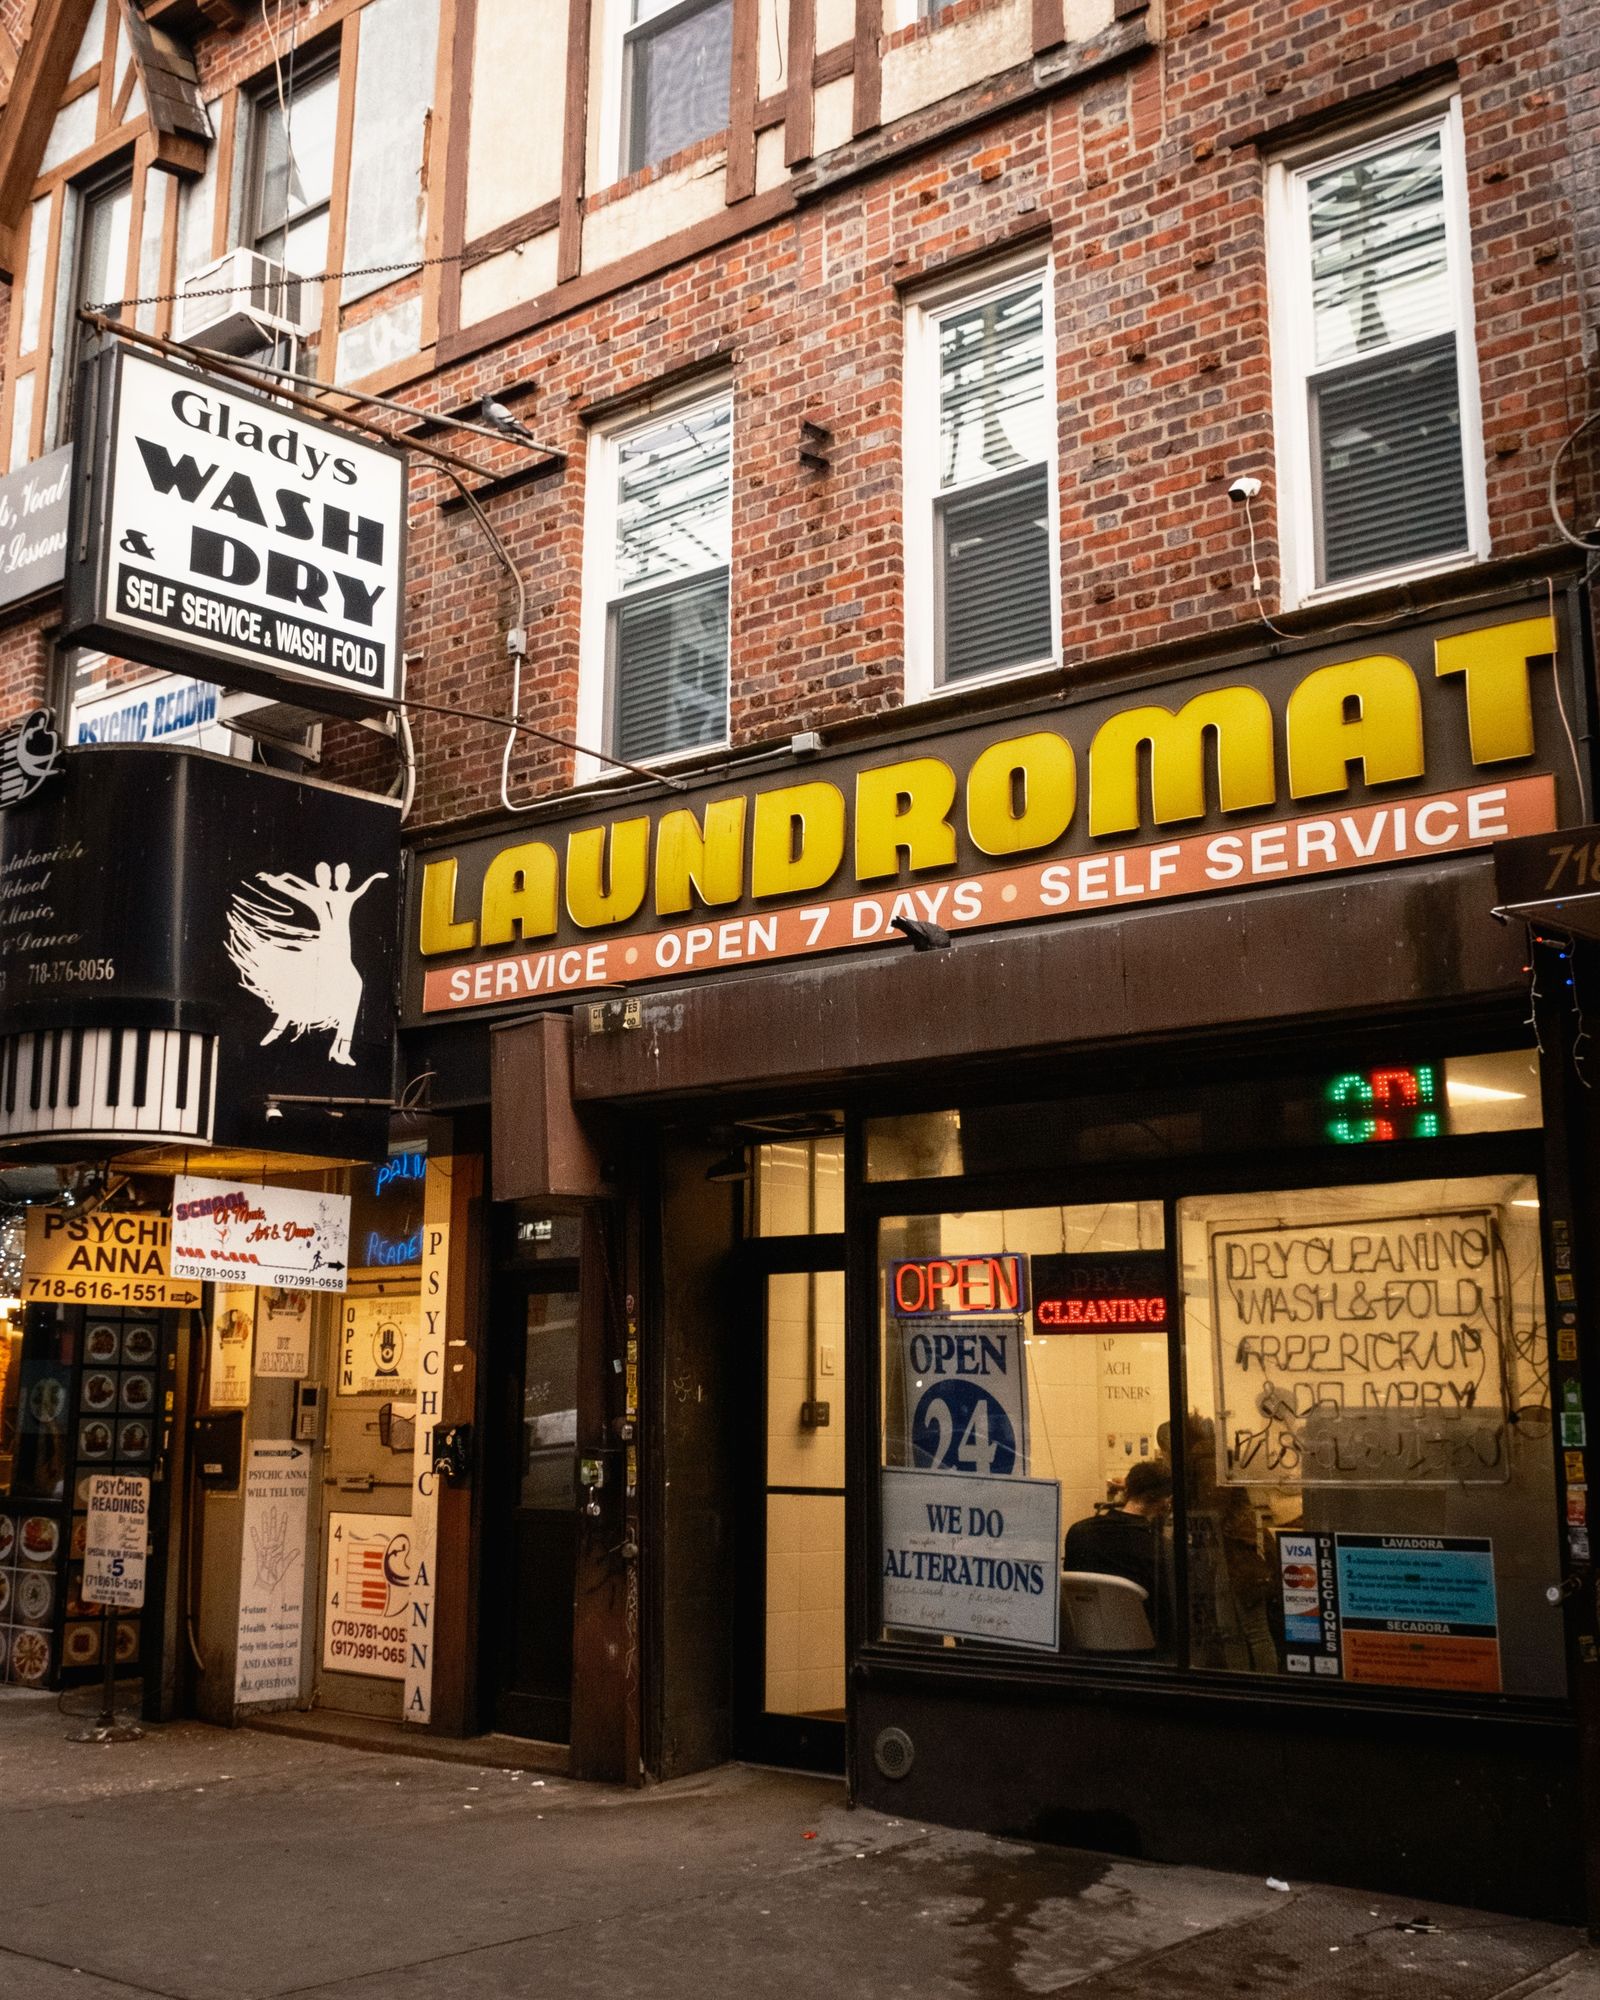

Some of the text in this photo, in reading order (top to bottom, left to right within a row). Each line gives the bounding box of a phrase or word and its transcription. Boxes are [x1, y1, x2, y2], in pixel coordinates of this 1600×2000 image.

[171, 389, 358, 486] Gladys
[21, 463, 69, 517] Vocal
[134, 435, 385, 566] WASH
[4, 528, 68, 574] Lessons
[119, 525, 386, 627] & DRY
[125, 575, 378, 678] SELF SERVICE & WASH FOLD
[78, 682, 219, 746] PSYCHIC READIN
[419, 615, 1559, 956] LAUNDROMAT
[448, 788, 1510, 1003] SERVICE OPEN 7 DAYS SELF SERVICE
[16, 931, 81, 951] Dance
[28, 957, 115, 985] 718-376-8056
[175, 1191, 249, 1221] SCHOOL
[44, 1213, 172, 1247] PSYCHI
[67, 1245, 165, 1276] ANNA
[174, 1264, 344, 1289] (718)781-0053 (917)991-0658
[28, 1278, 166, 1302] 718-616-1551
[895, 1257, 1019, 1313] OPEN
[1037, 1297, 1167, 1325] CLEANING
[343, 1307, 356, 1386] OPEN
[909, 1334, 1008, 1376] OPEN
[923, 1397, 998, 1474] 24
[96, 1479, 143, 1497] PSYCHIC
[248, 1487, 307, 1498] WILL TELL YOU
[249, 1470, 308, 1480] PSYCHIC ANNA
[91, 1496, 145, 1514] READINGS
[926, 1503, 1005, 1539] WE DO
[1285, 1545, 1313, 1557] VISA
[1382, 1537, 1445, 1550] LAVADORA
[884, 1549, 1045, 1596] ALTERATIONS
[1319, 1537, 1338, 1652] DIRECCIONES
[1387, 1620, 1450, 1634] SECADORA
[330, 1640, 407, 1664] (917)991-065
